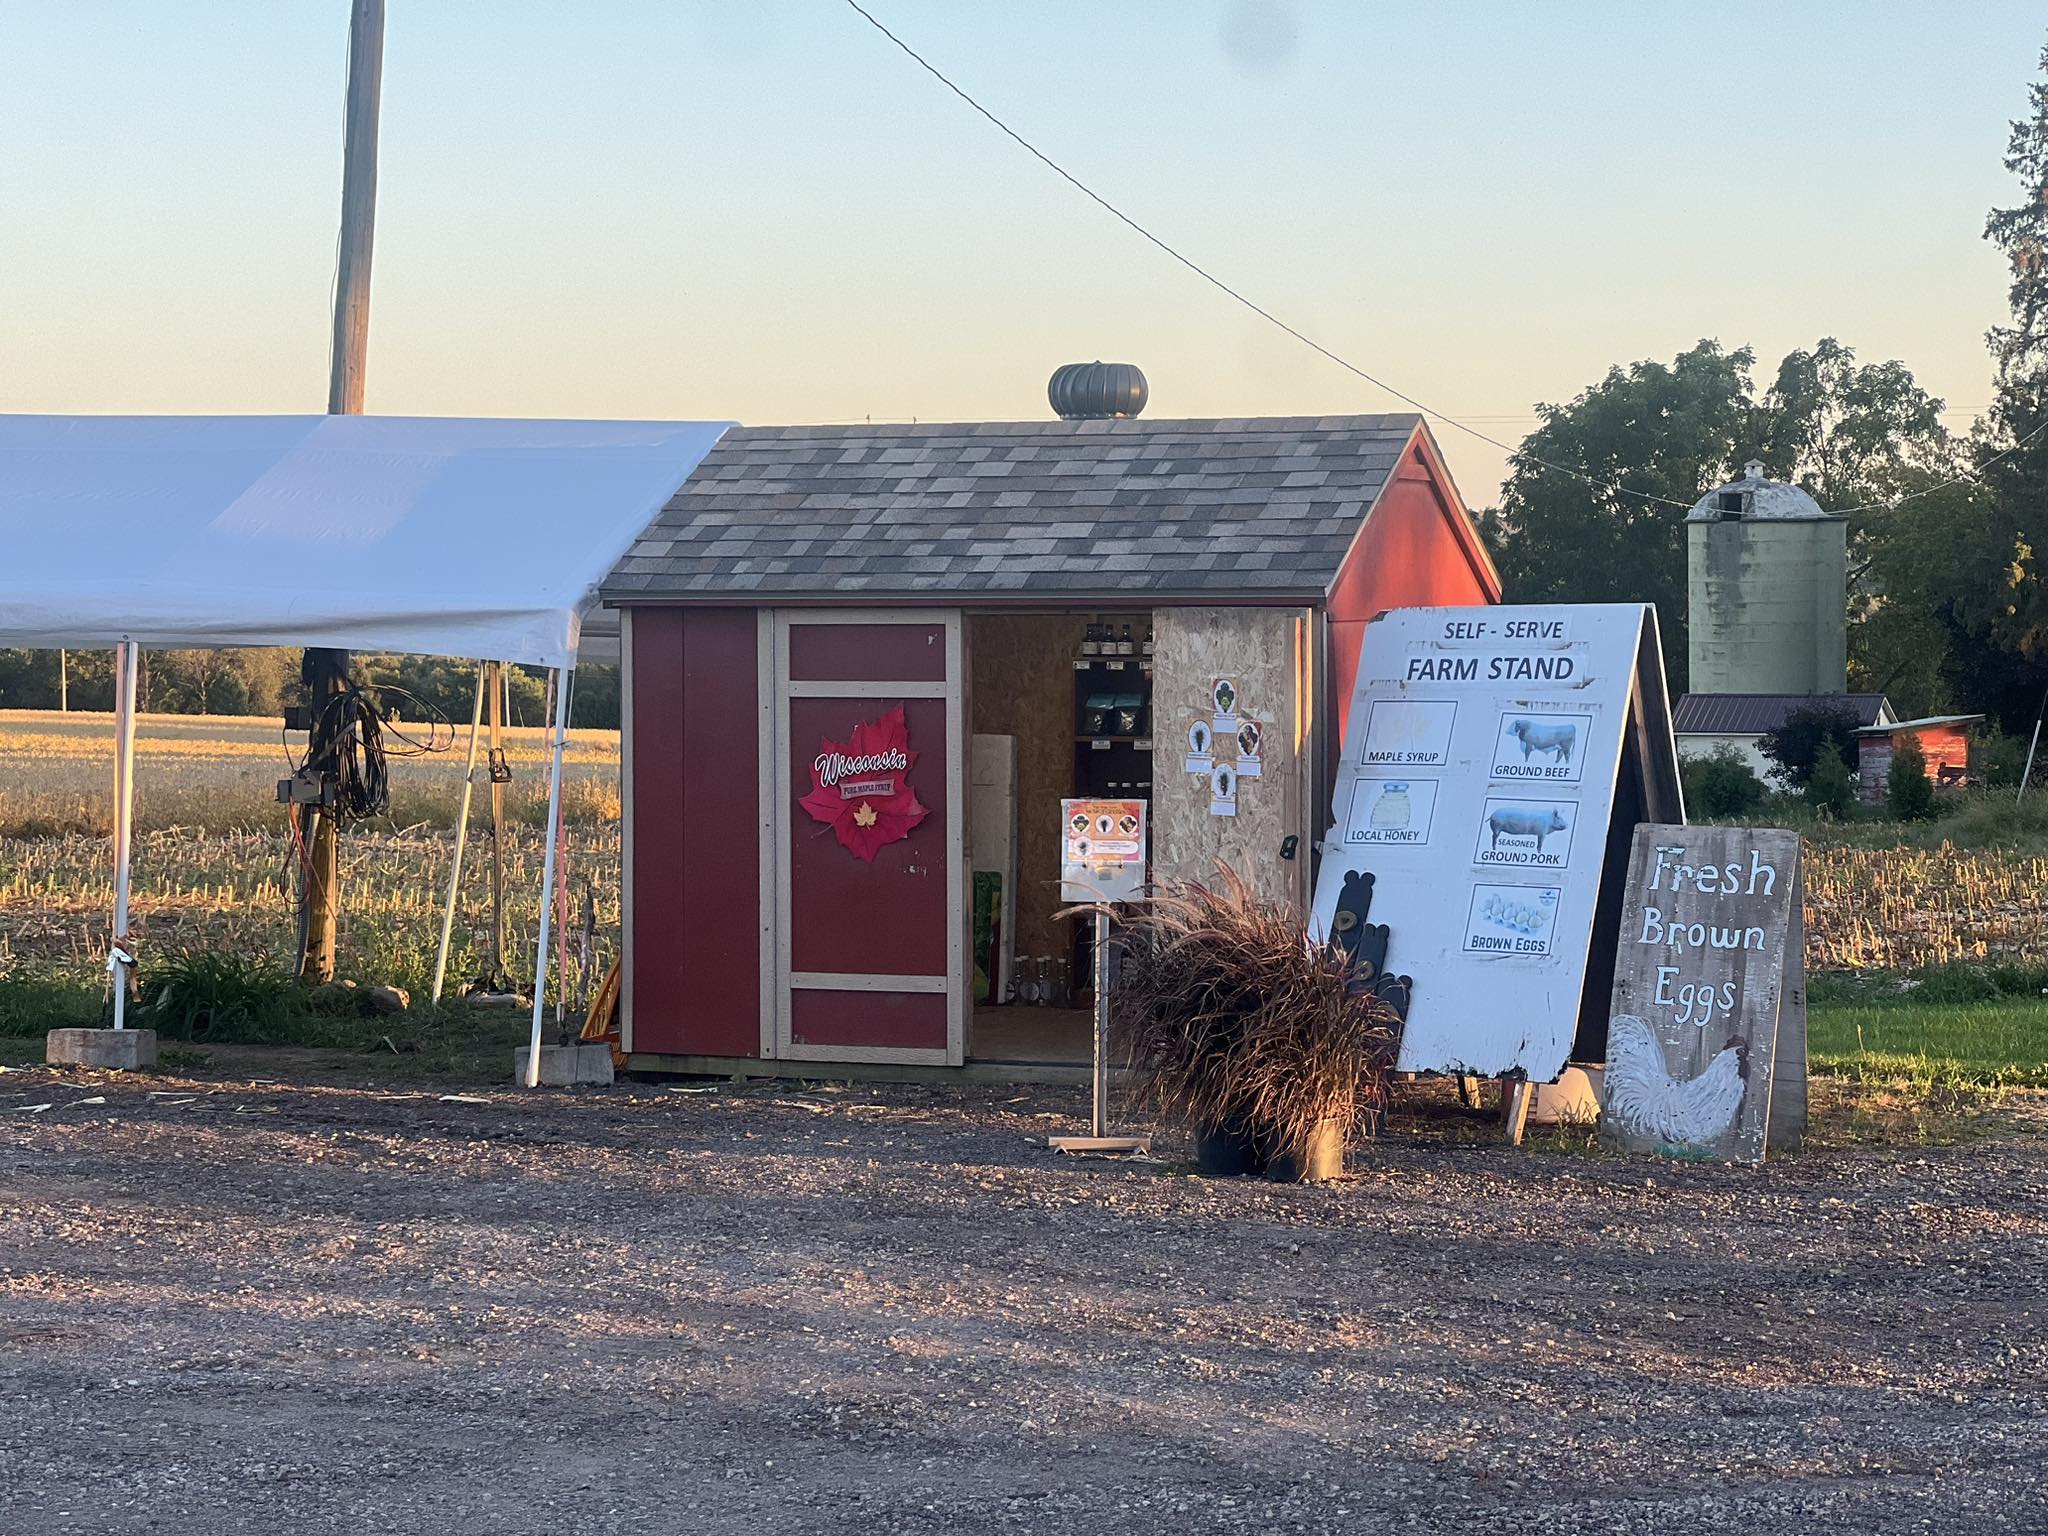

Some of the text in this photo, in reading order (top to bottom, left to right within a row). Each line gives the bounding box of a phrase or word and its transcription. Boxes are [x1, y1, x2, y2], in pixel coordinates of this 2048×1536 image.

[1444, 622, 1486, 640] SELF
[1504, 621, 1564, 640] SERVE
[1407, 657, 1574, 681] FARM STAND
[1368, 751, 1439, 763] MAPLE SYRUP
[815, 748, 907, 788] Wisconsin
[1495, 765, 1570, 778] GROUND BEEF
[1351, 830, 1420, 842] LOCAL HONEY
[1498, 838, 1536, 849] SEASONED
[1481, 850, 1560, 865] GROUND PORK
[1648, 846, 1777, 897] Fresh
[1637, 906, 1766, 951] Brown
[1471, 935, 1546, 952] BROWN EGGS
[1653, 965, 1737, 1028] Eggs
